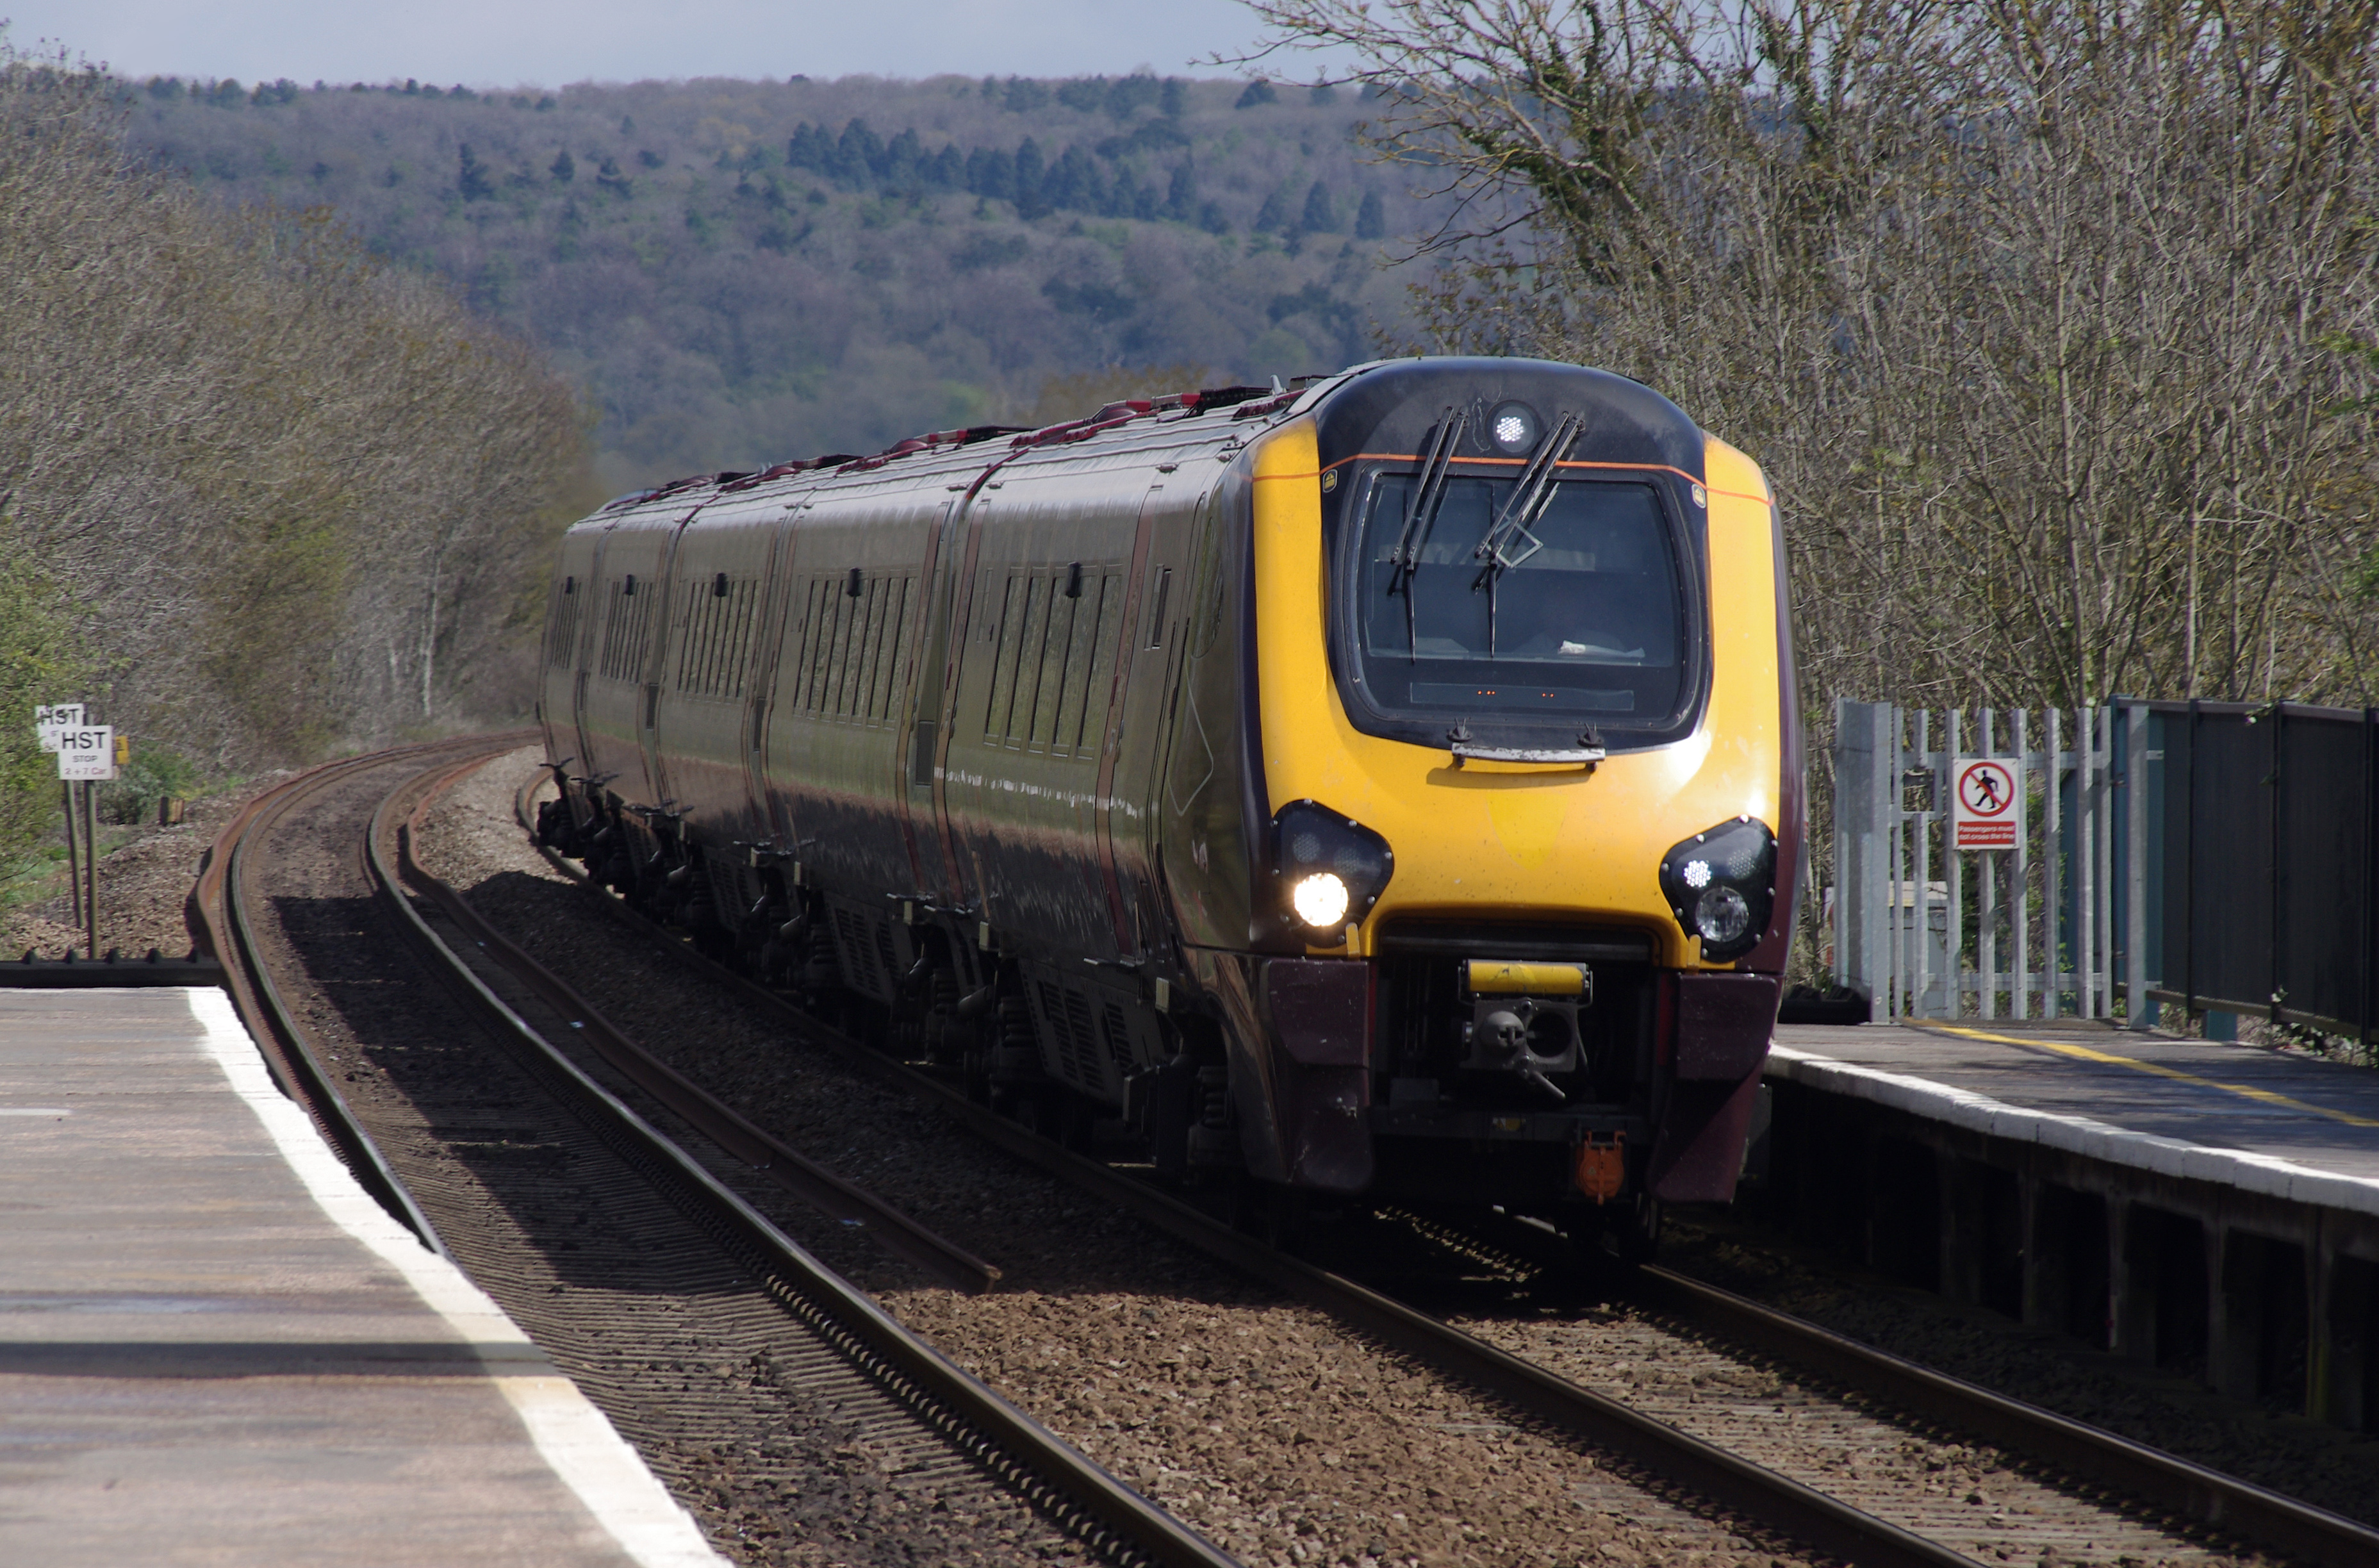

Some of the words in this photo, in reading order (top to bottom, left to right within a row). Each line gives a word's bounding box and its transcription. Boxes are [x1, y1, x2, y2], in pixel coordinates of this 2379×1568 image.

[39, 708, 80, 725] HST
[62, 731, 107, 749] HST
[72, 755, 98, 763] STOP
[92, 767, 107, 775] Car
